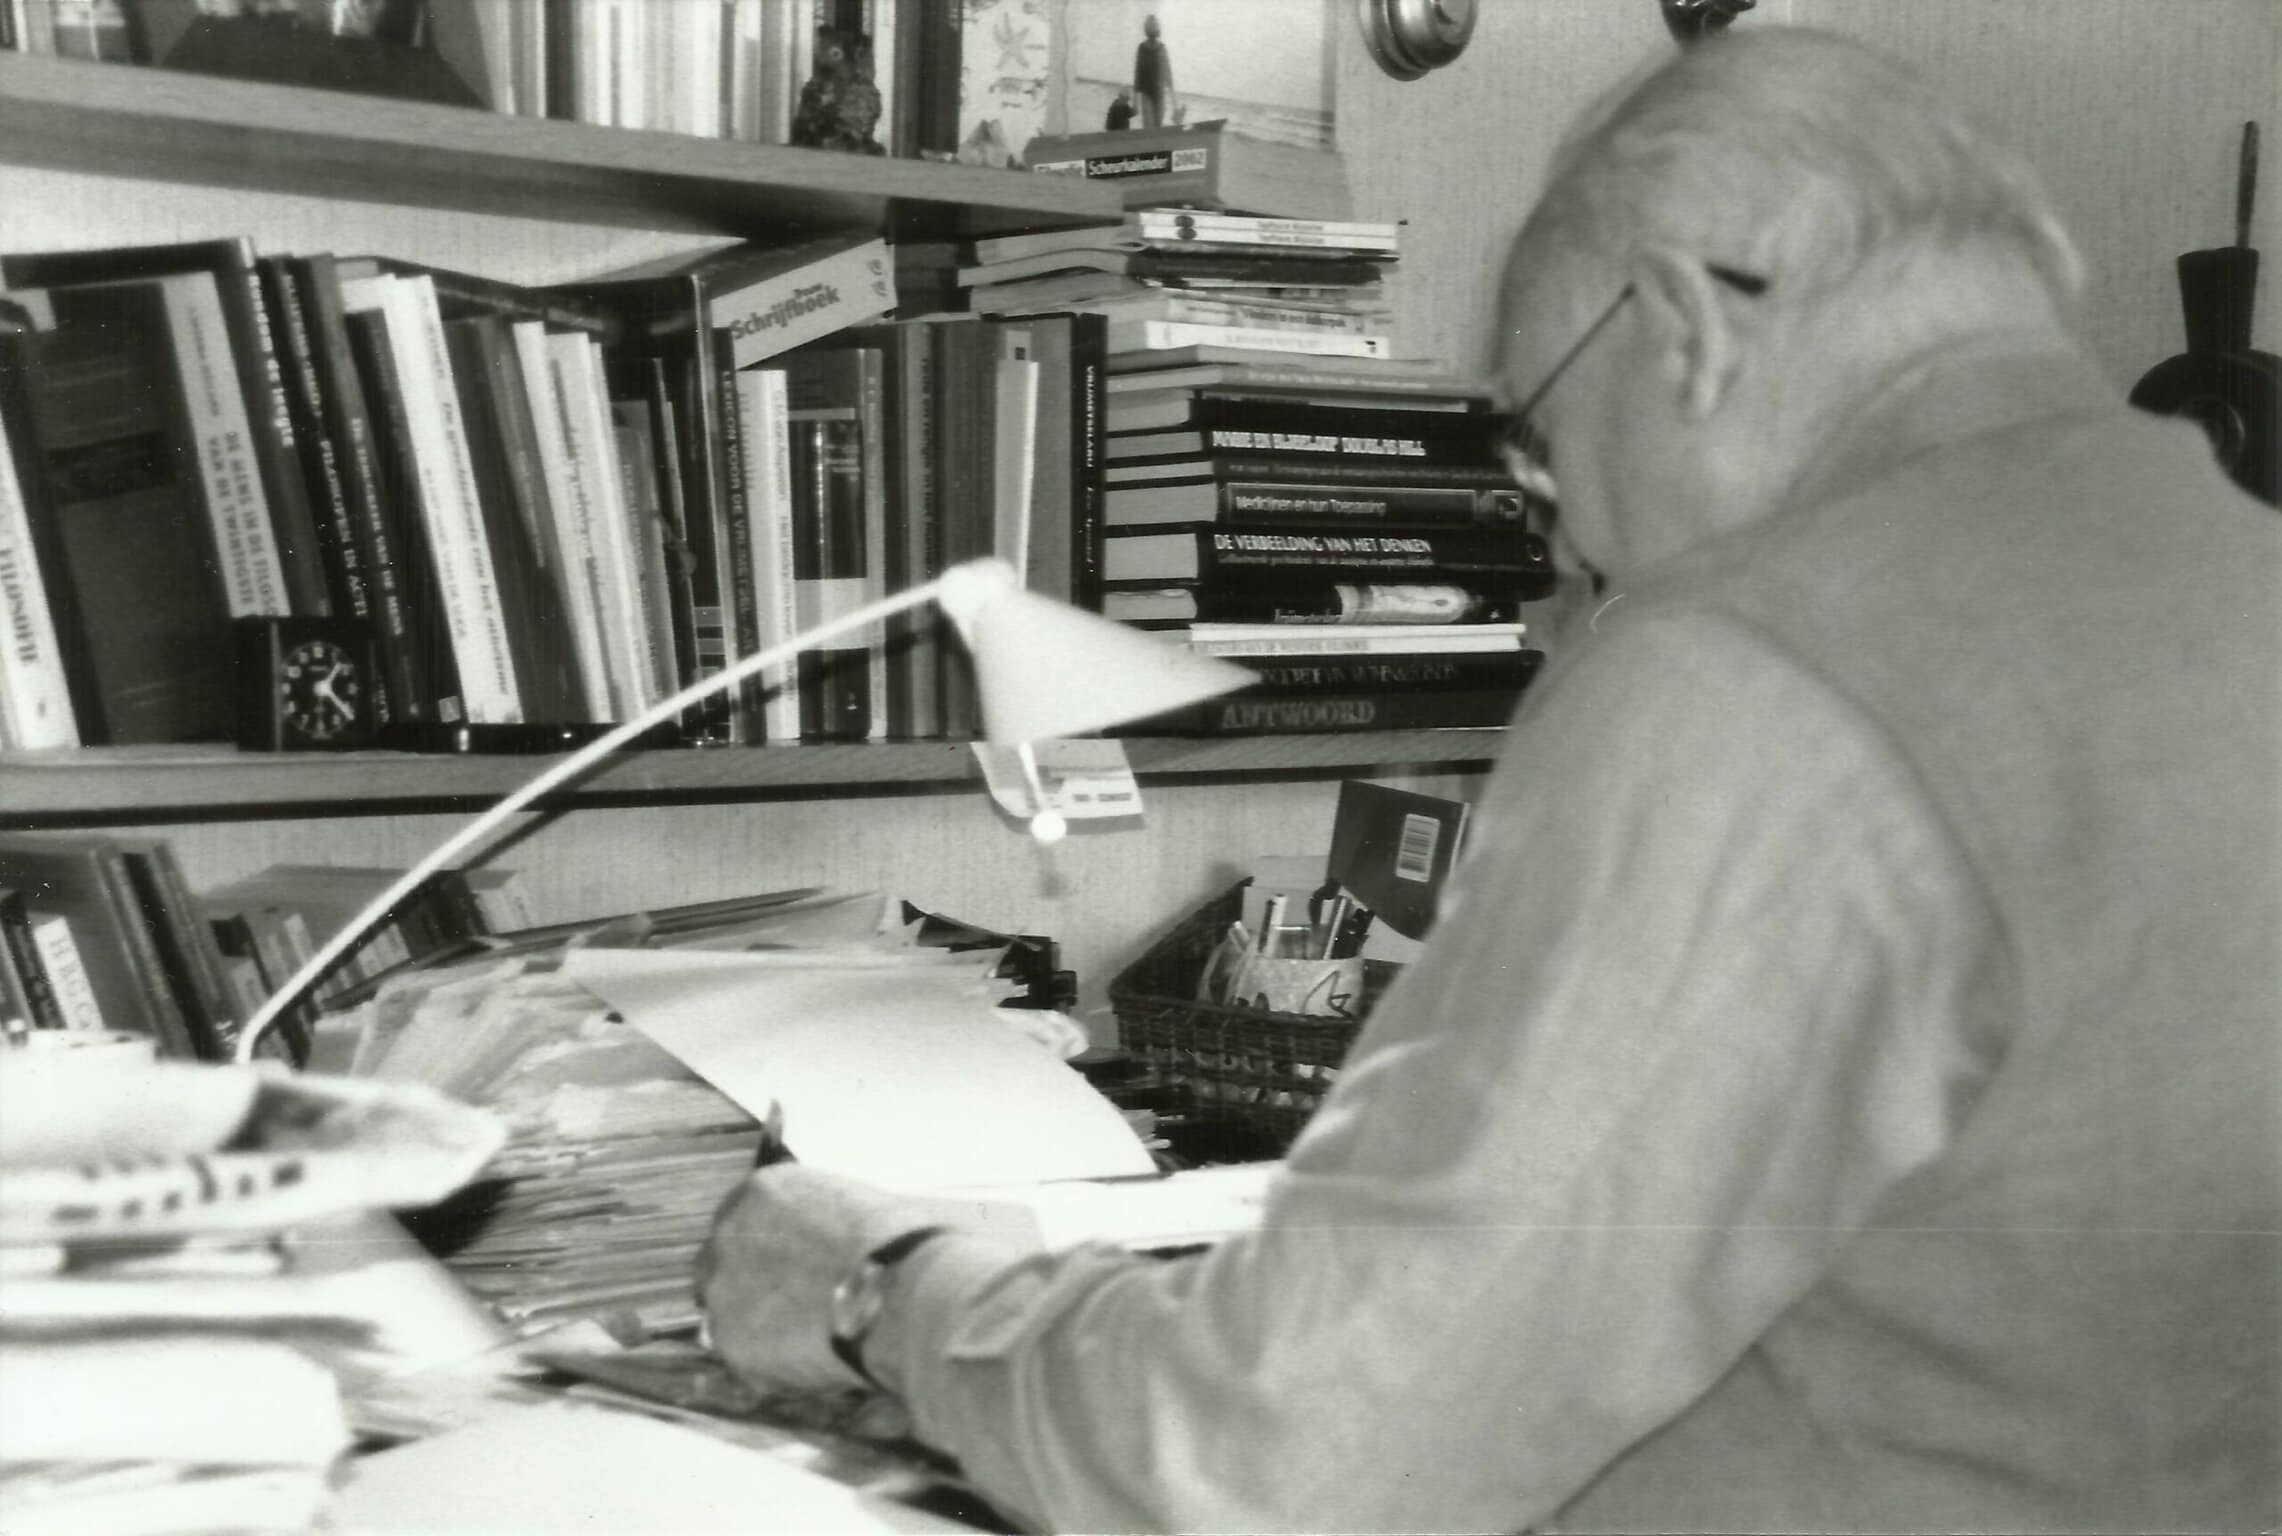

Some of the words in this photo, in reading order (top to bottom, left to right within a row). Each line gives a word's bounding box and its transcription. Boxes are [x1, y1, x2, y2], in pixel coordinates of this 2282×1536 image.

[730, 284, 841, 341] Schrijfboek
[1214, 534, 1234, 549] DE
[1234, 535, 1323, 551] VERBEELDING
[1324, 537, 1352, 551] VAN
[1353, 538, 1378, 551] HET
[1379, 538, 1432, 552] DENKEN
[1221, 699, 1377, 729] ANTWOORD
